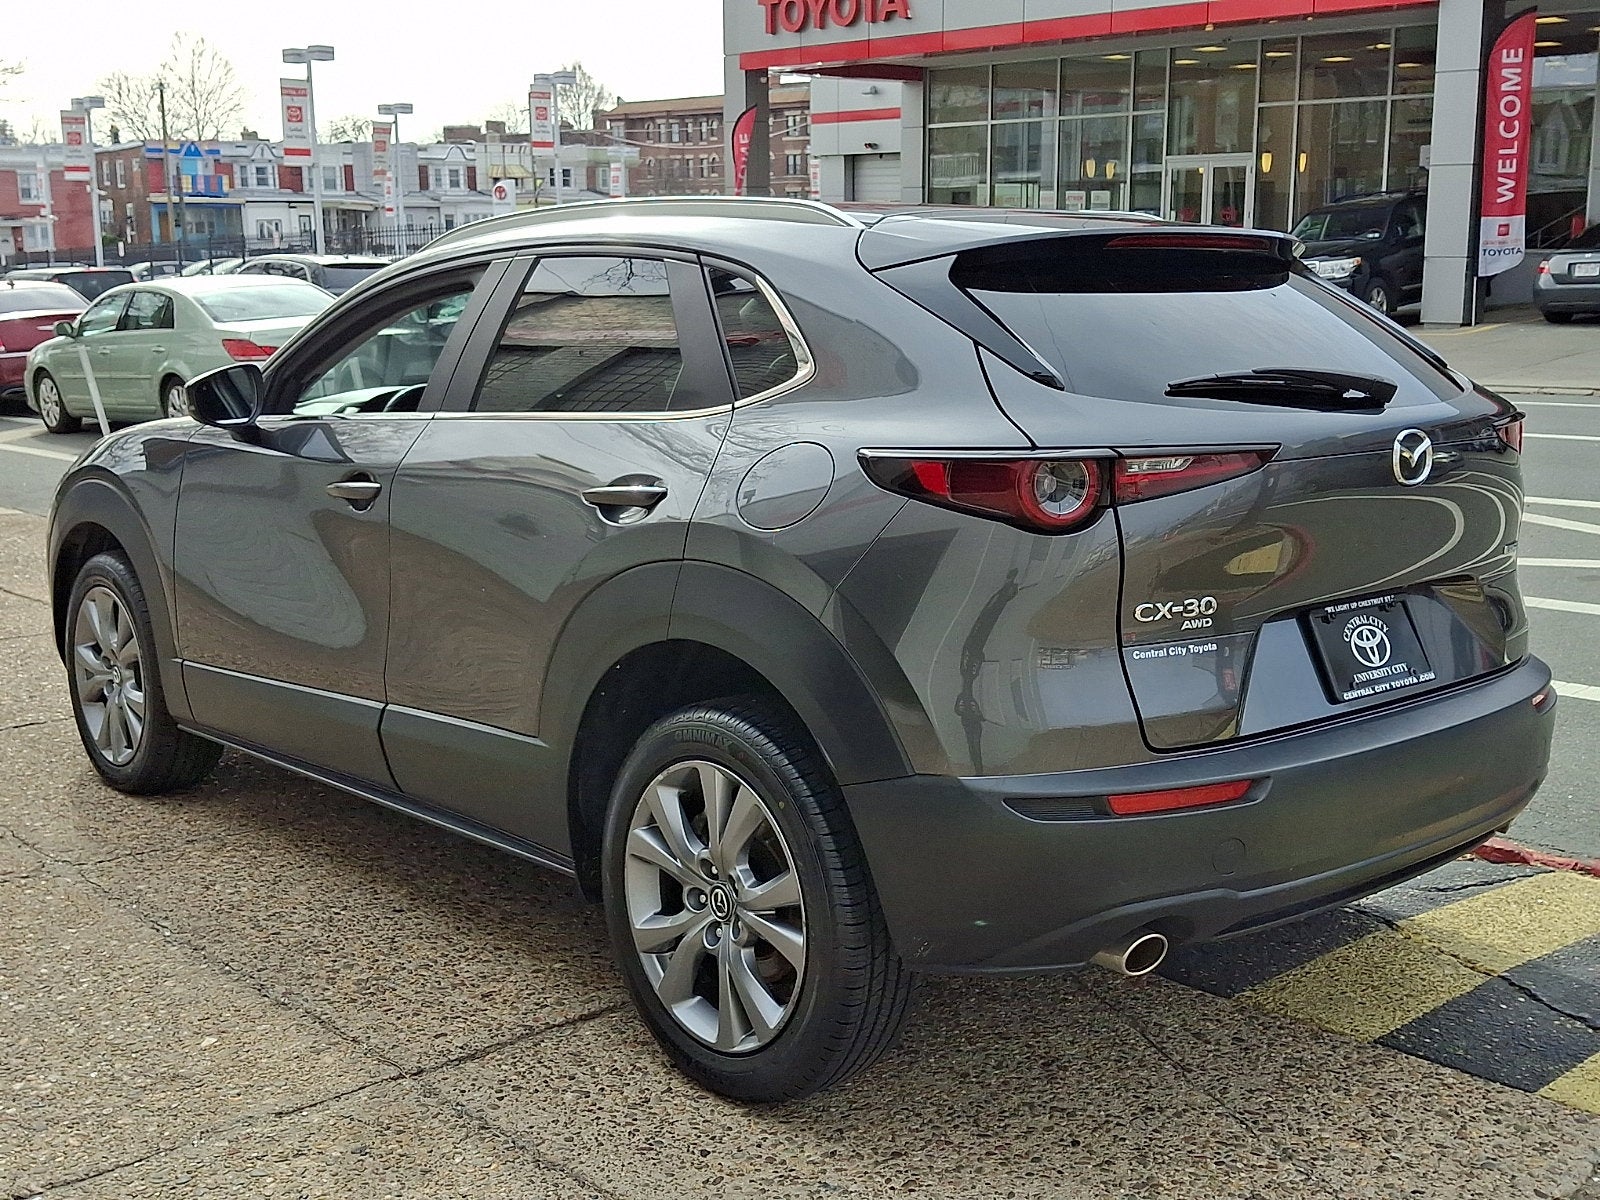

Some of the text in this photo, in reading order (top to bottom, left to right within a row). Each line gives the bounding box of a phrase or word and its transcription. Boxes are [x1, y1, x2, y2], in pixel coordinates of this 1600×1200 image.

[758, 0, 911, 35] TOYOTA
[1496, 47, 1524, 204] WELCOME
[1482, 247, 1523, 257] TOYOTA
[1134, 596, 1218, 622] CX-30
[1180, 617, 1213, 631] AWD
[1343, 614, 1390, 642] CENTRAL CITY
[1132, 642, 1218, 660] Central City Toyota
[1343, 672, 1436, 700] CENTRAL CITY TOYOTA .COM
[1353, 662, 1408, 684] UNIVERSITY CITY
